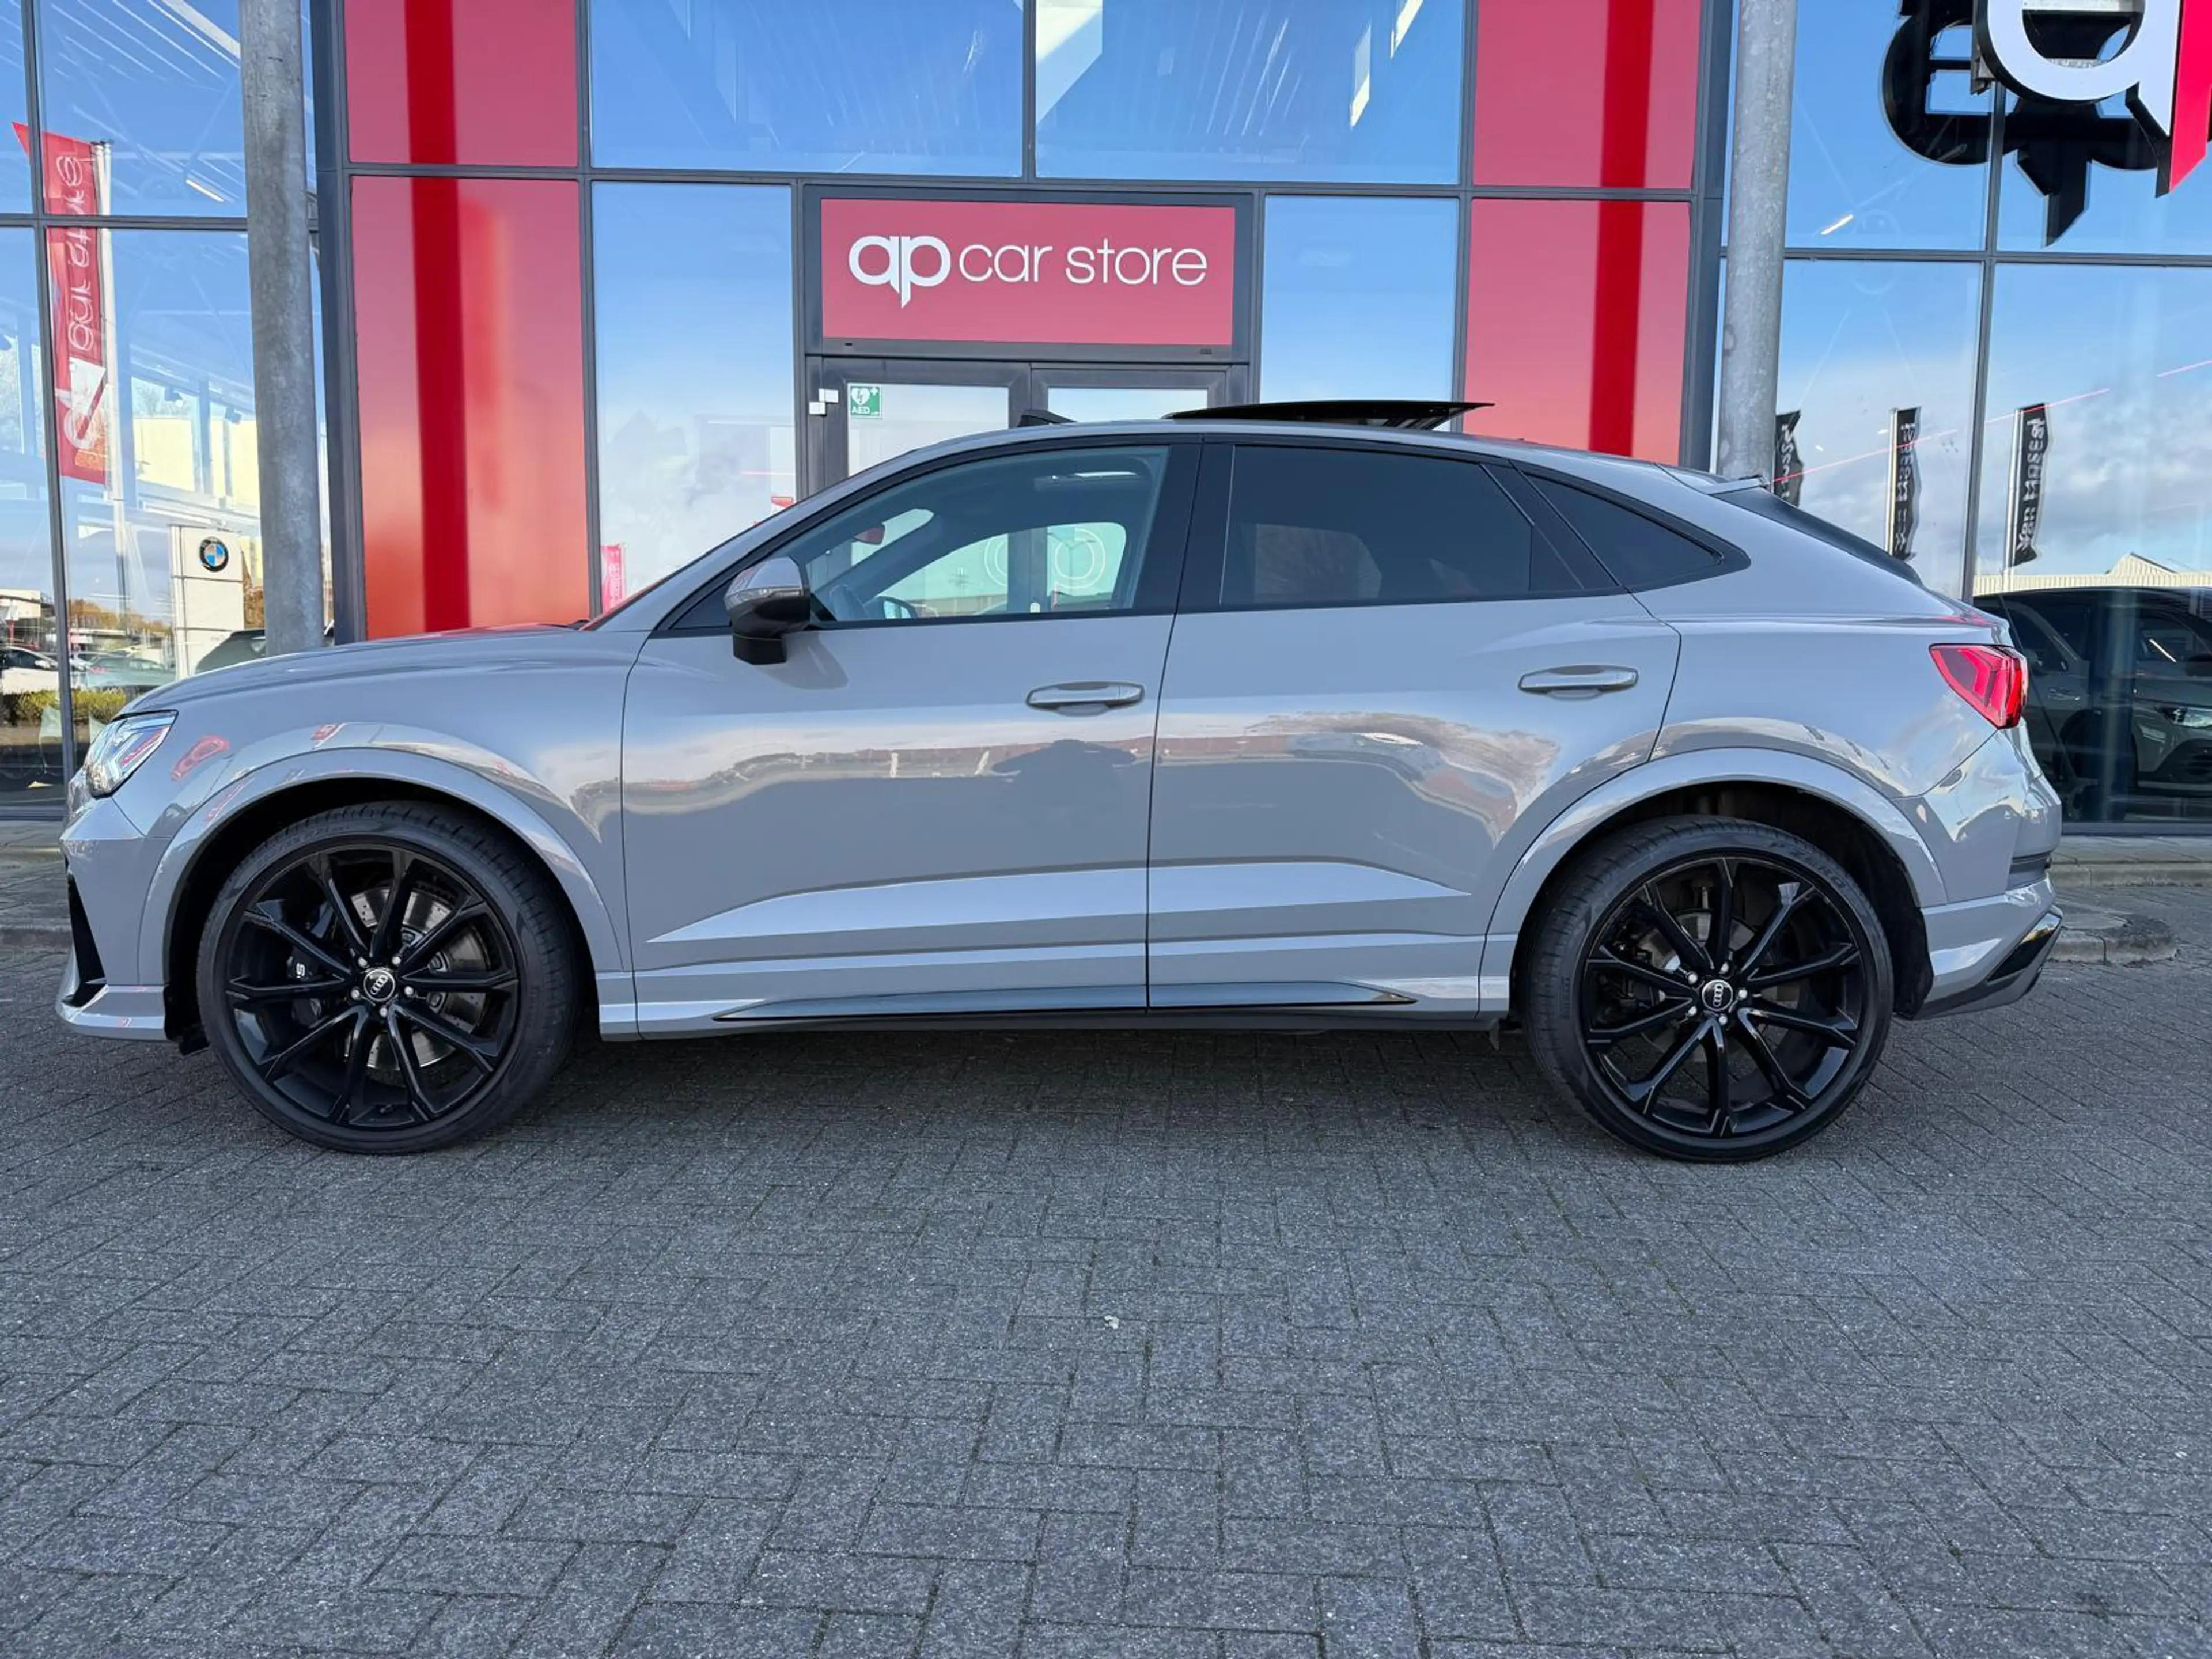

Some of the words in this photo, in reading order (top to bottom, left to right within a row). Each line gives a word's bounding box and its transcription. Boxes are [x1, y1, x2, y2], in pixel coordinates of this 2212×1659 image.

[849, 236, 951, 308] ap
[959, 244, 1052, 282] car
[1065, 238, 1207, 285] store
[851, 406, 870, 414] AED
